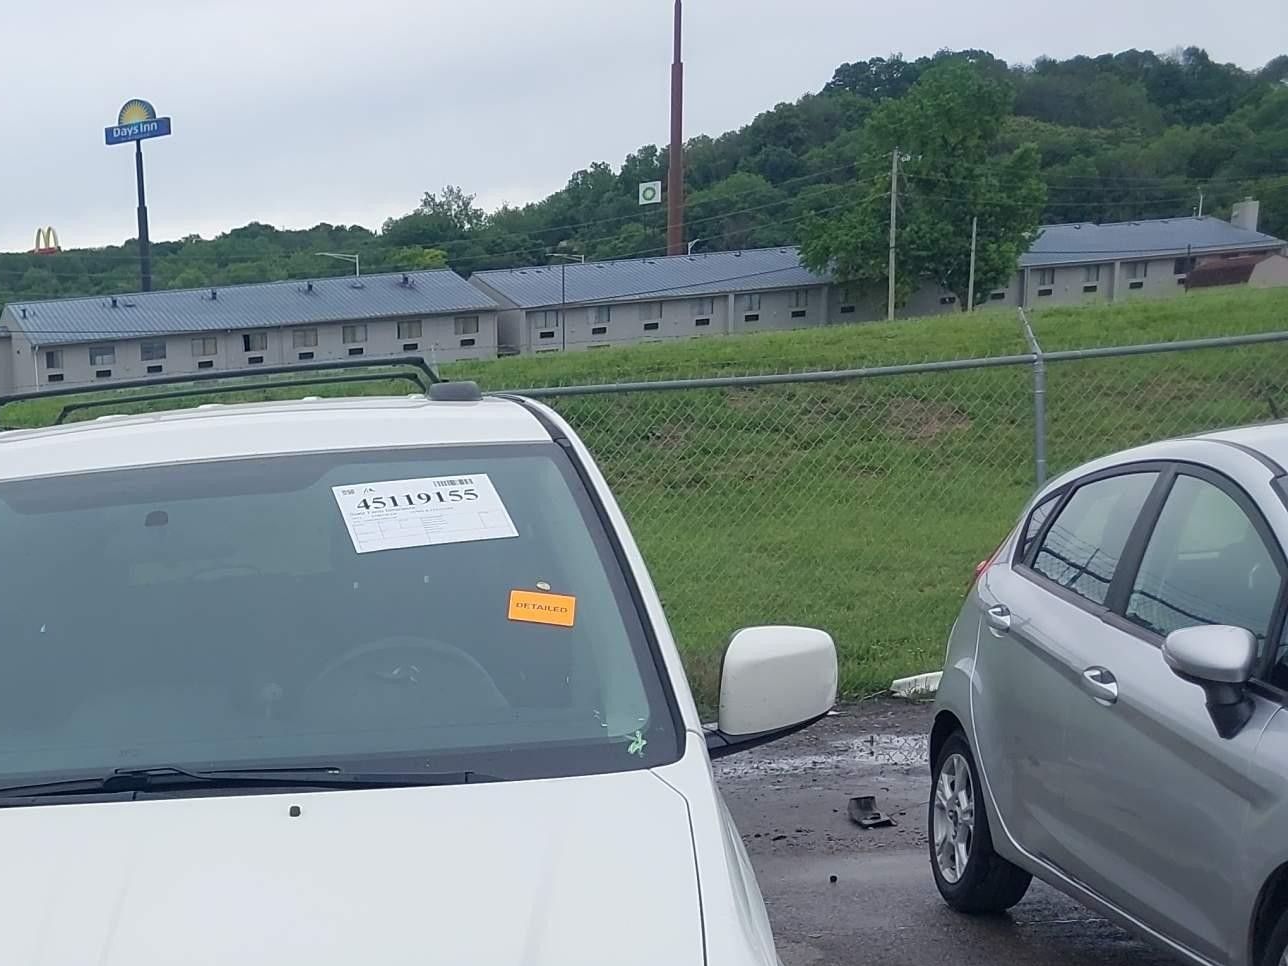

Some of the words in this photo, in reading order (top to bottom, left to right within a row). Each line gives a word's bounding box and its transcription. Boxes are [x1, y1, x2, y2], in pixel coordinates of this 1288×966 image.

[113, 124, 139, 138] Days
[140, 121, 158, 133] Inn
[356, 488, 480, 511] 45119155
[515, 602, 569, 613] DETAILED
